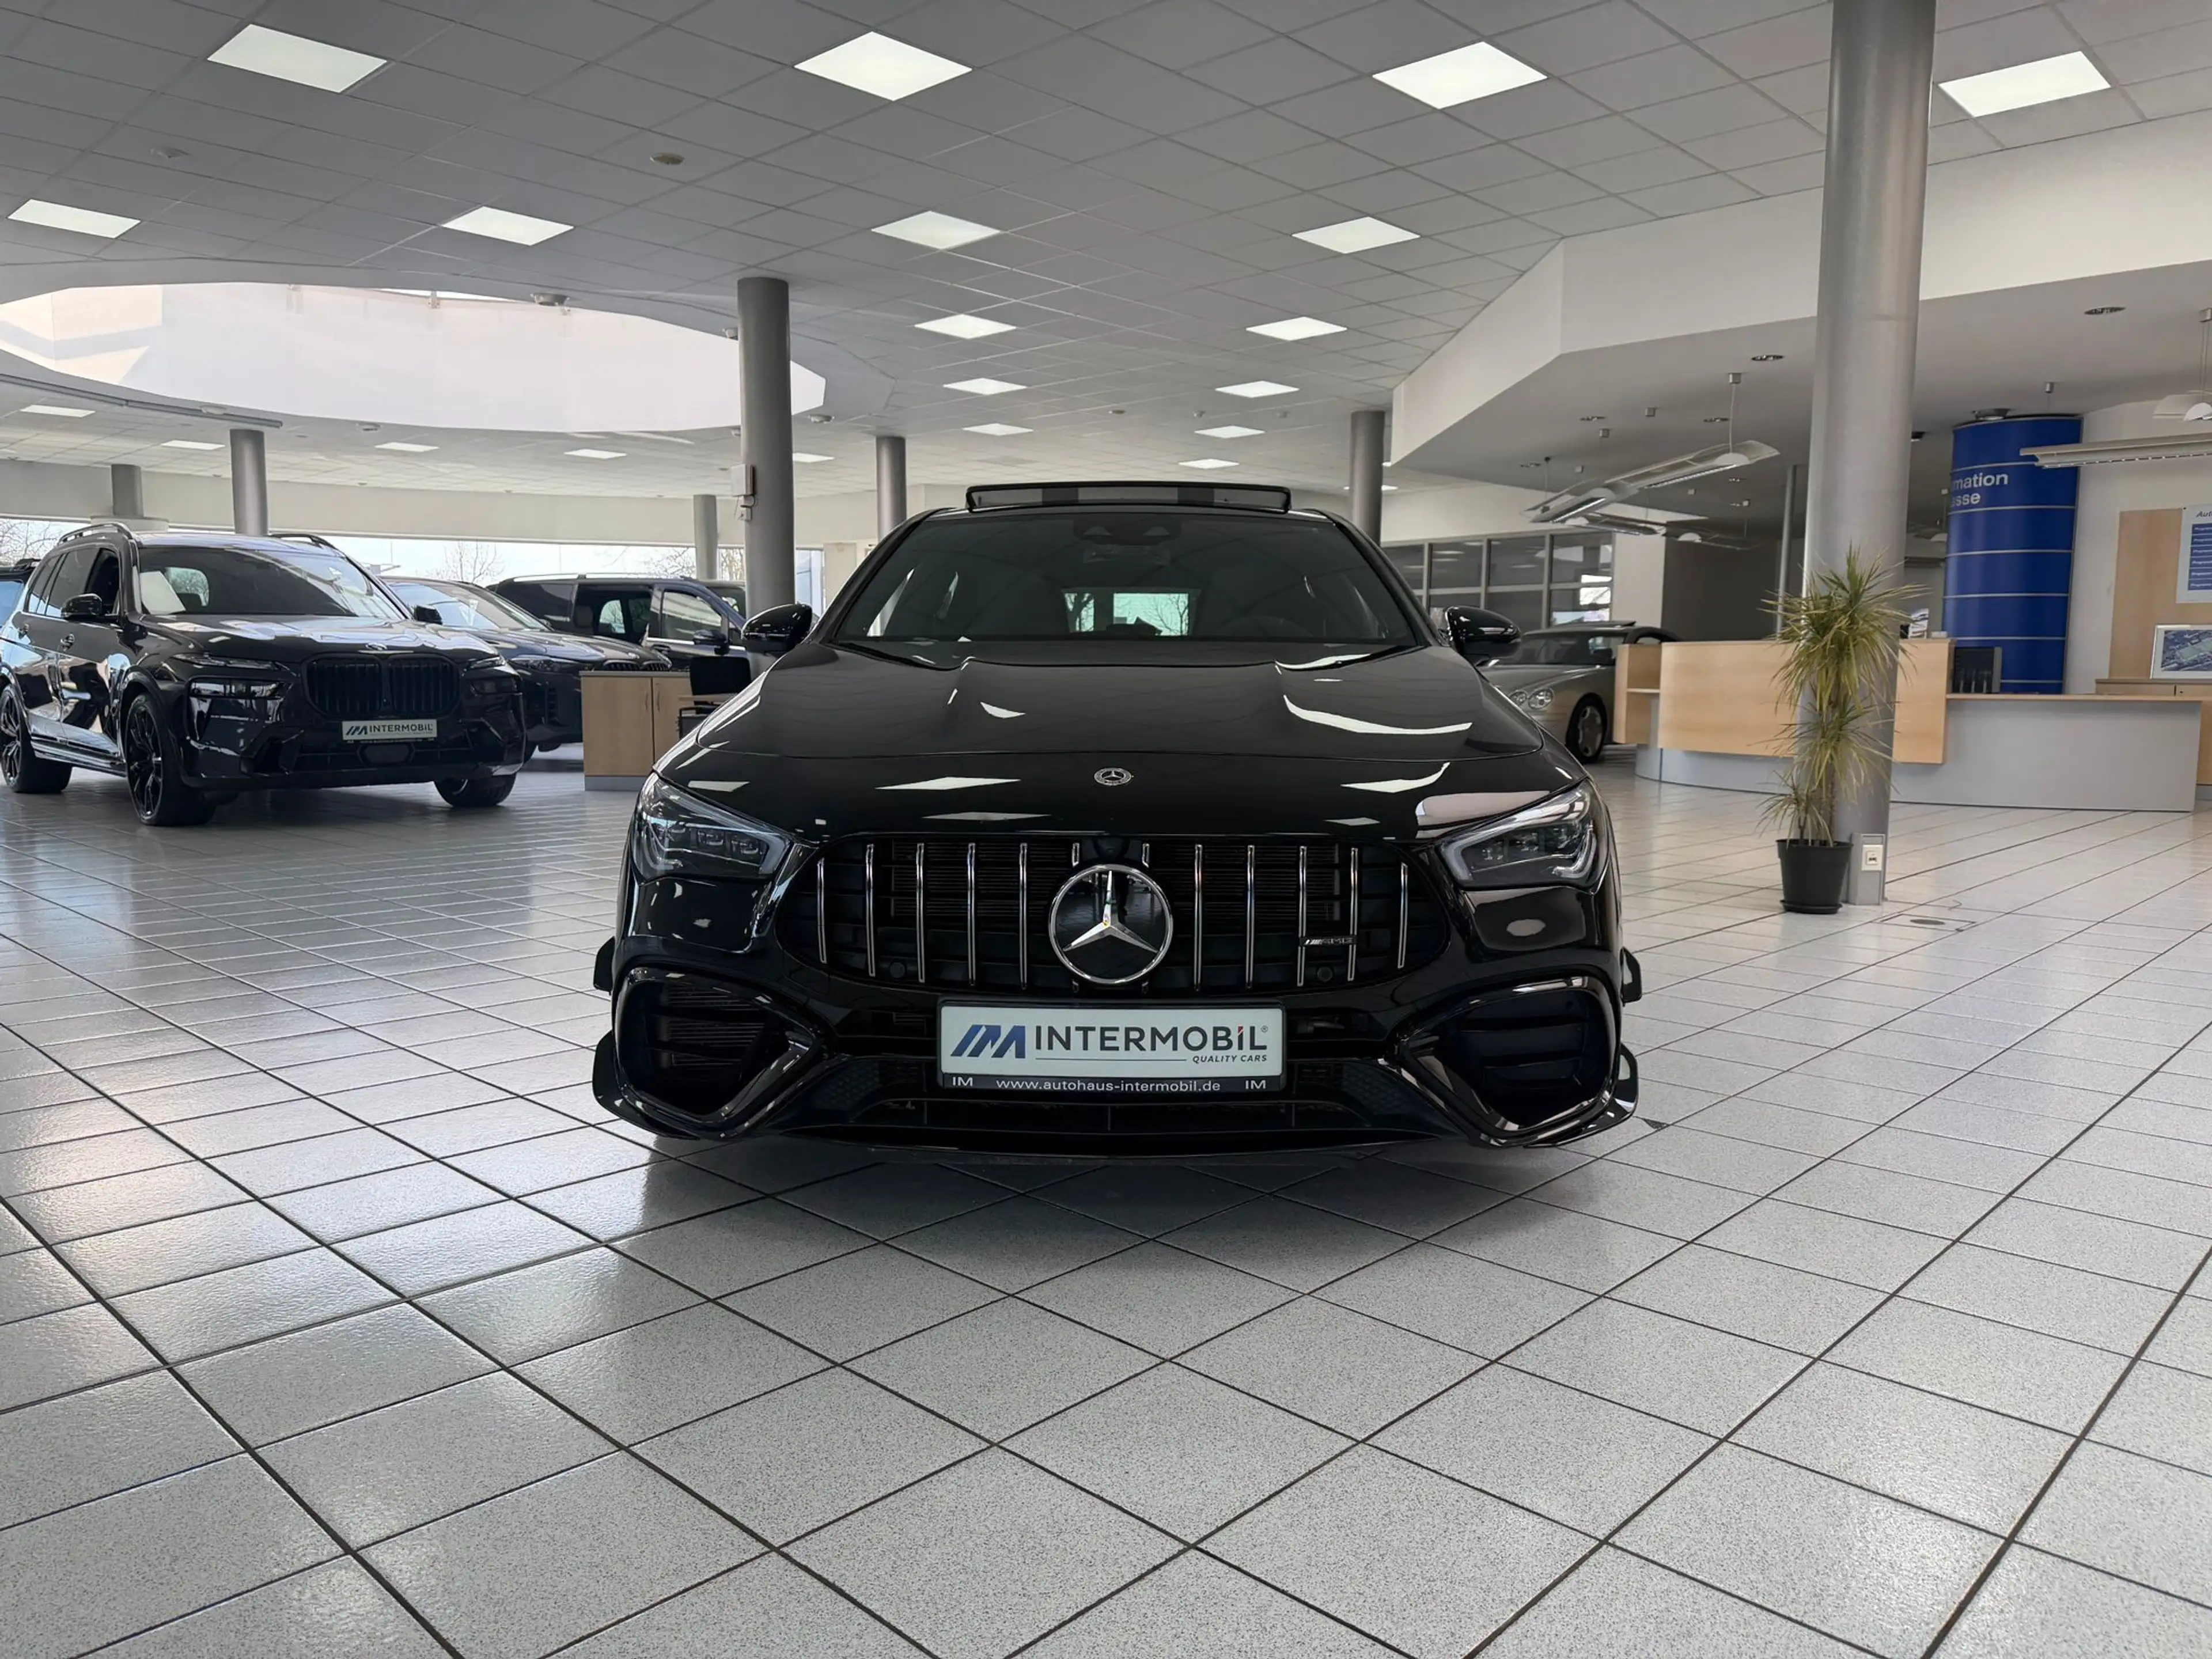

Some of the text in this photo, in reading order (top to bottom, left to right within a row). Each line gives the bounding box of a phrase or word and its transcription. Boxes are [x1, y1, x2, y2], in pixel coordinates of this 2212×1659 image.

[1952, 493, 1981, 506] sse
[1192, 1055, 1237, 1063] QUALITY
[952, 1076, 1266, 1092] IM www.autohaus-intermobil.de IM
